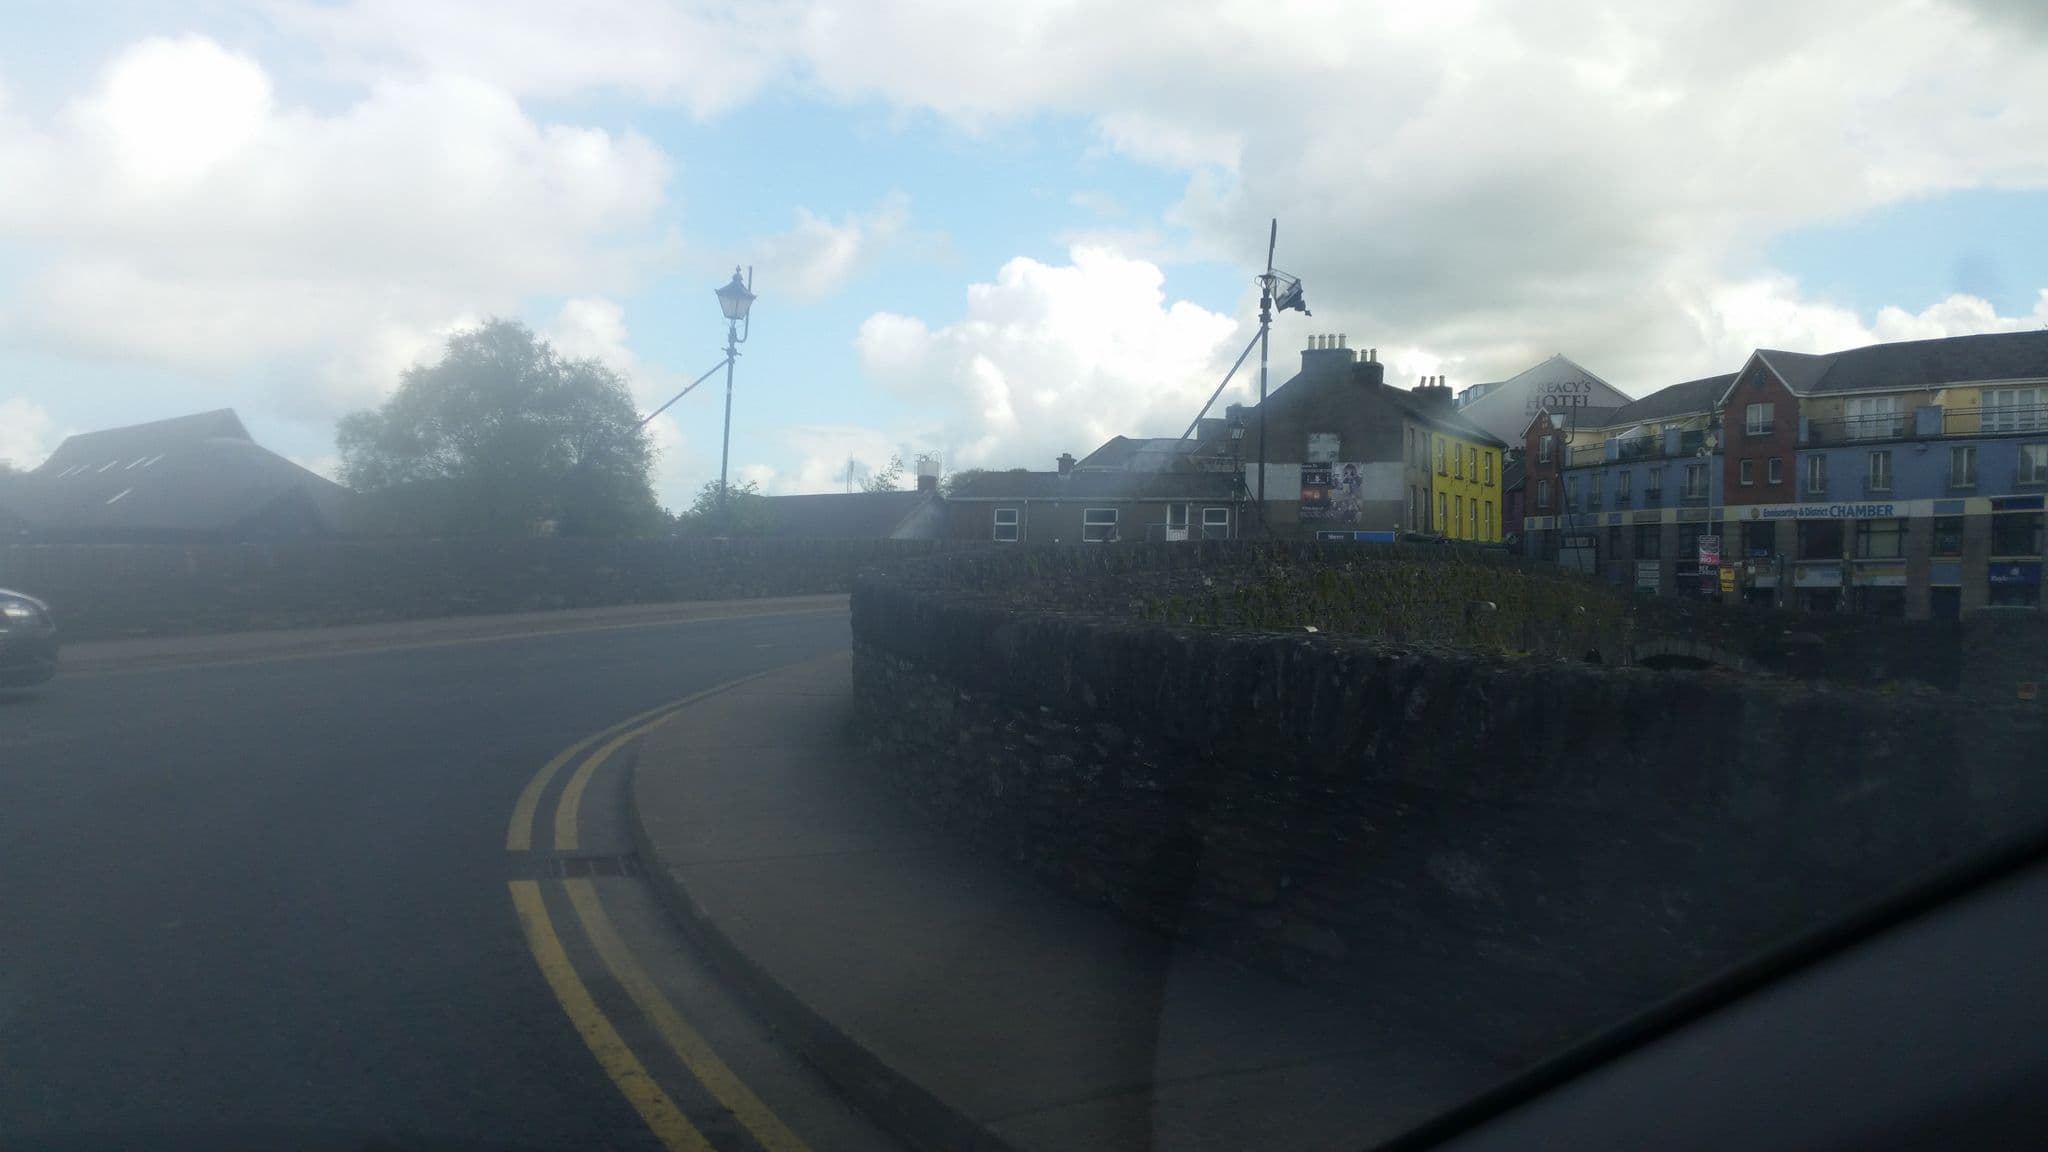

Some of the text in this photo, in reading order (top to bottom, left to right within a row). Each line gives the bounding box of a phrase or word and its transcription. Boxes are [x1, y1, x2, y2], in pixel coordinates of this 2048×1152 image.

[1531, 381, 1591, 393] REACY'S
[1527, 394, 1589, 408] HOTEL
[1805, 506, 1829, 517] District
[1829, 504, 1894, 518] CHAMBER
